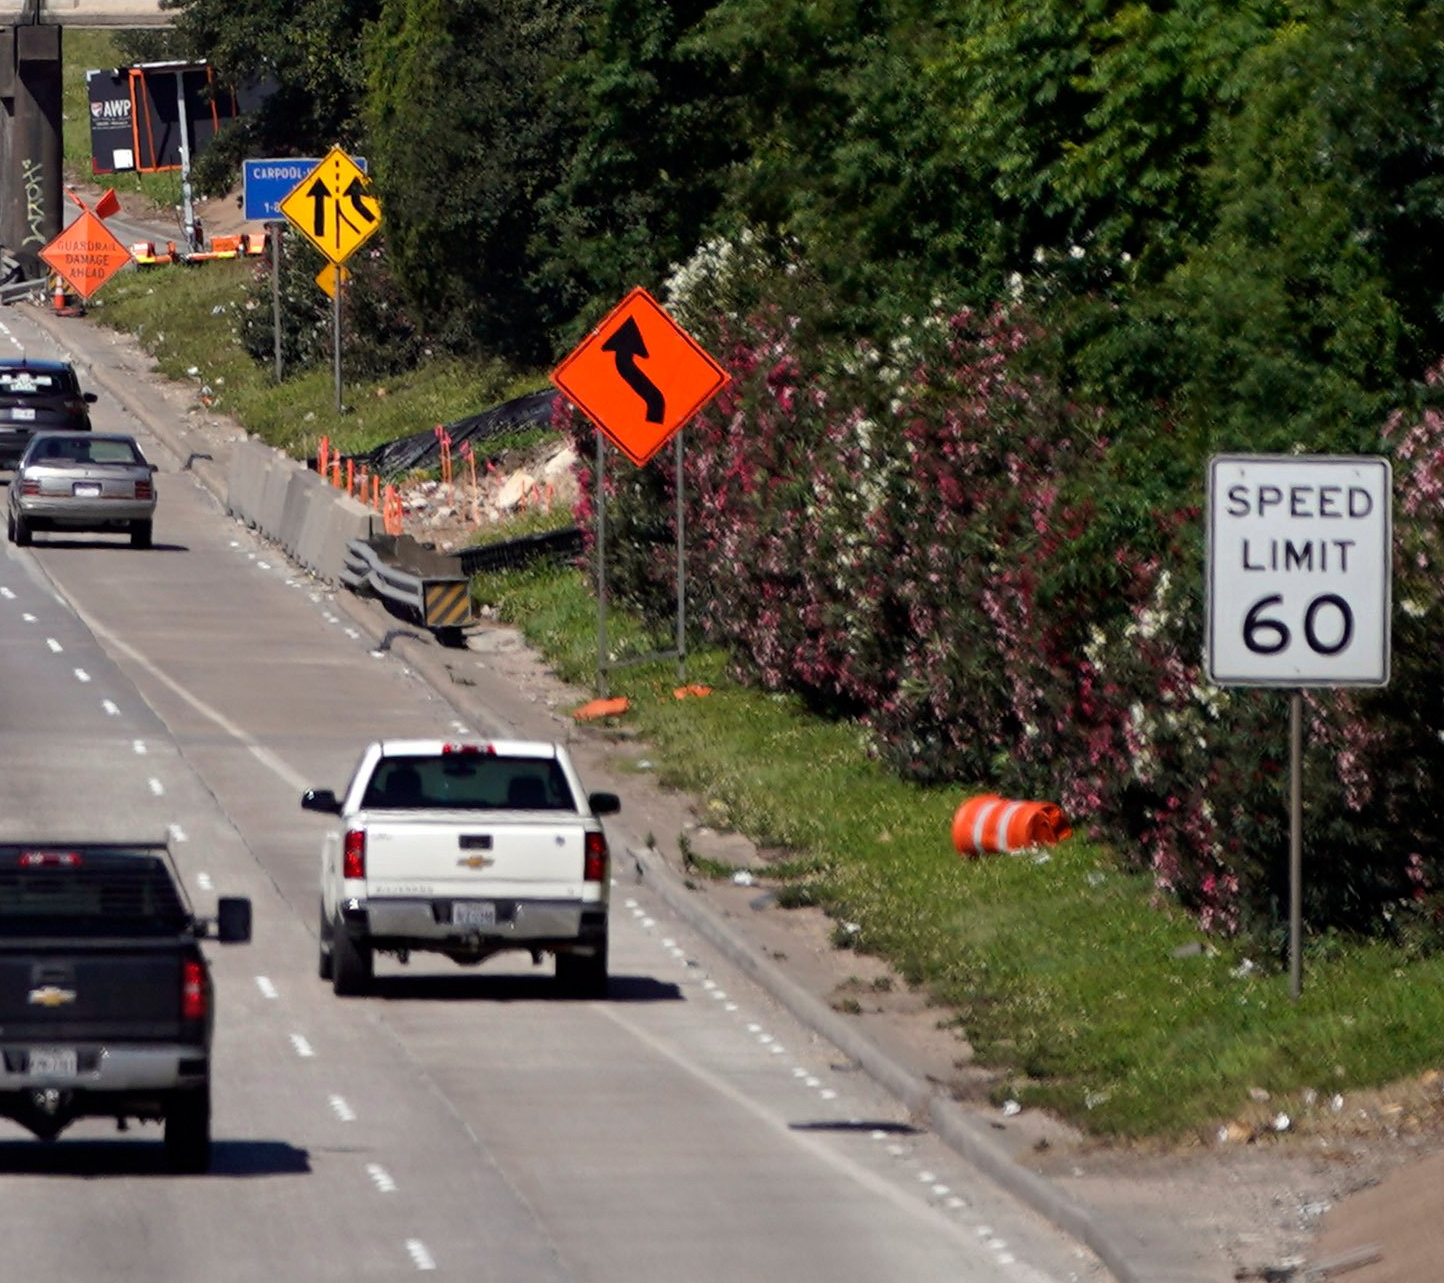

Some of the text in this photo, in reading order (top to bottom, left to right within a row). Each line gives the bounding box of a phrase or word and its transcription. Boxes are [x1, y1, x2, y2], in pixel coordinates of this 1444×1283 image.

[103, 99, 132, 118] AWP
[57, 240, 117, 252] GUARDRAIL
[65, 253, 110, 266] DAMAGE
[69, 267, 105, 279] AHEAD
[1226, 485, 1374, 519] SPEED
[1241, 539, 1356, 573] LIMIT
[1242, 593, 1355, 656] 60
